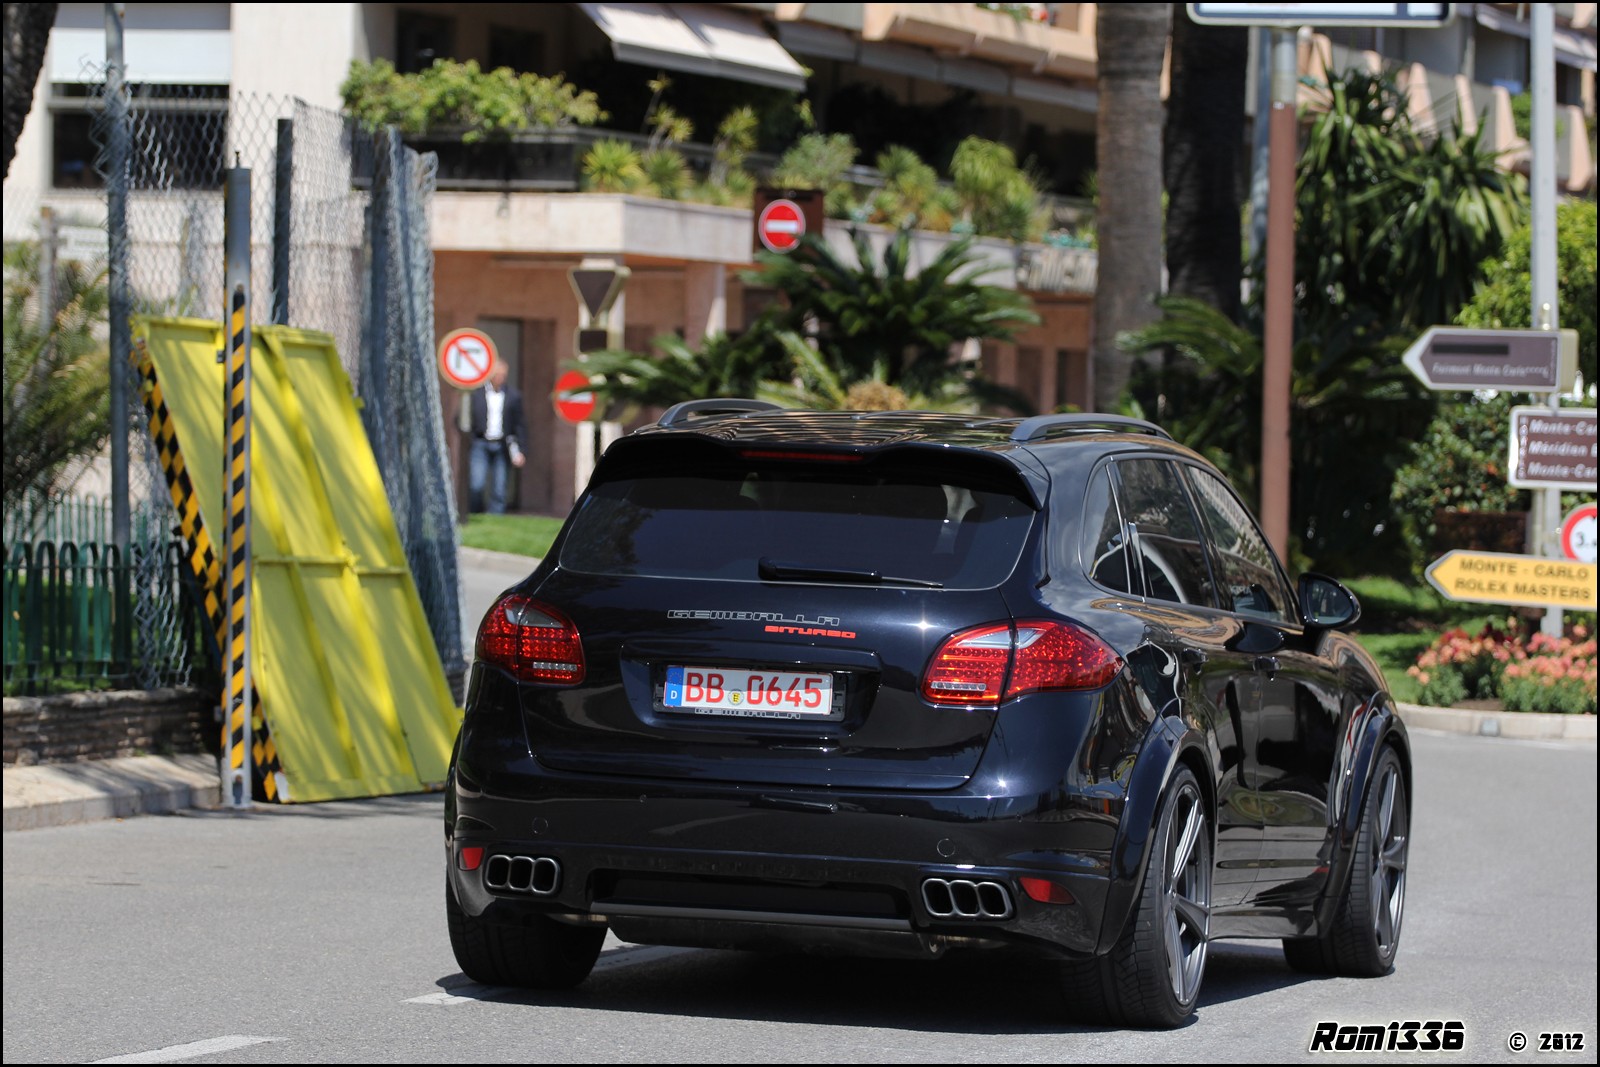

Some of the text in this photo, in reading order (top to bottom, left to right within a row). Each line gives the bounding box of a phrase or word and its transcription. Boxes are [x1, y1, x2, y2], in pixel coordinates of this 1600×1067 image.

[1460, 559, 1517, 574] MONTE
[1533, 564, 1590, 580] CARLO
[1455, 577, 1591, 600] ROLEX MASTERS
[667, 609, 840, 626] GEMBALLA
[764, 625, 856, 639] BITURBO
[670, 672, 823, 709] D BB 0645
